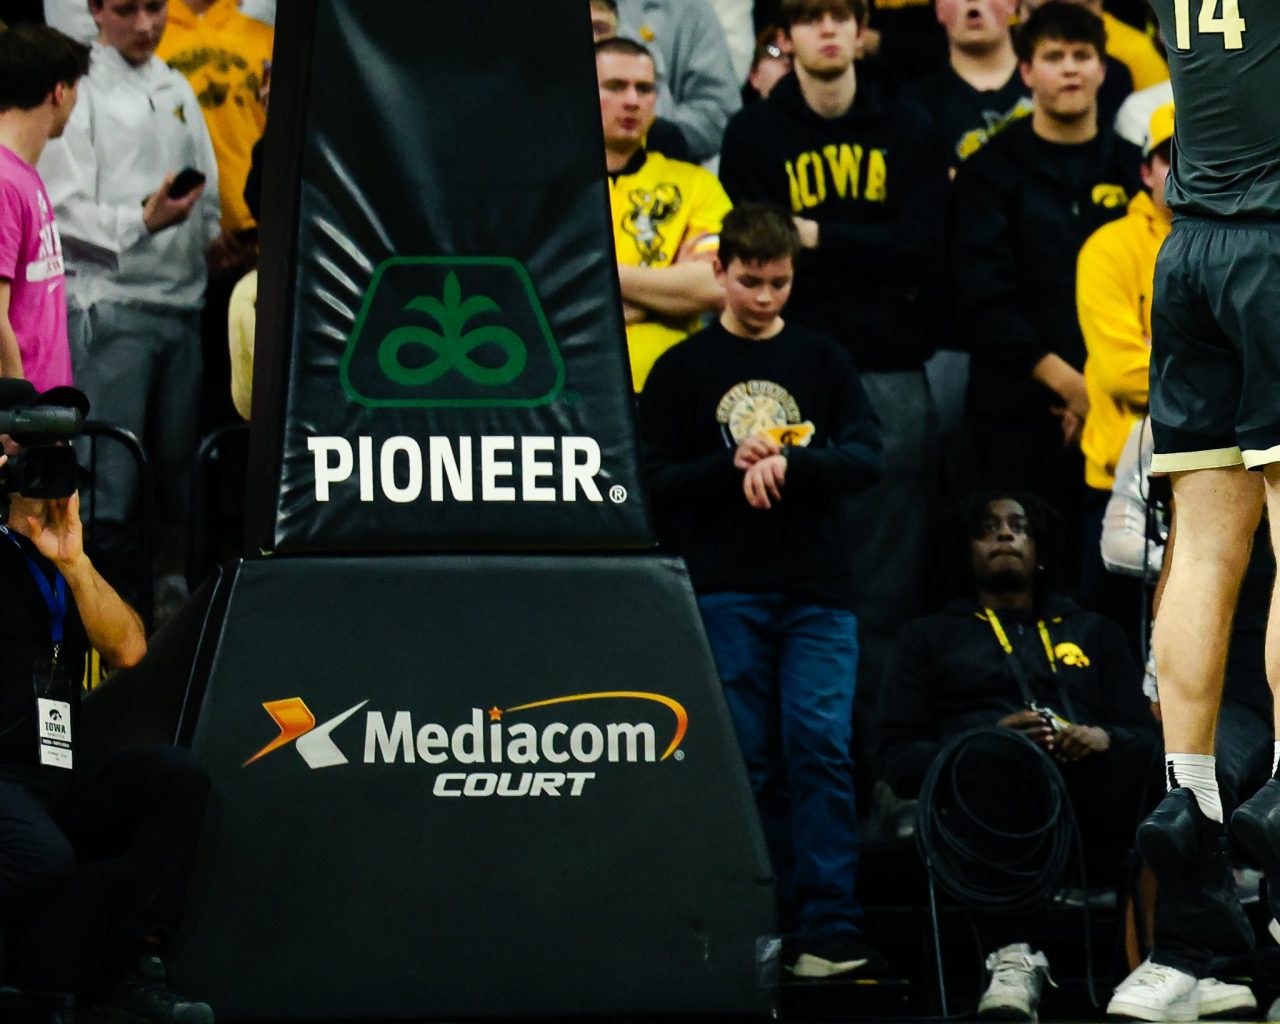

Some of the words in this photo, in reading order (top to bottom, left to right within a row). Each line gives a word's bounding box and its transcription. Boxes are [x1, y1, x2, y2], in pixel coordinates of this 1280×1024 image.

[784, 143, 887, 213] IOWA
[307, 435, 604, 503] PIONEER
[45, 721, 66, 734] IOWA
[363, 707, 656, 764] Mediacom
[432, 772, 596, 797] COURT
